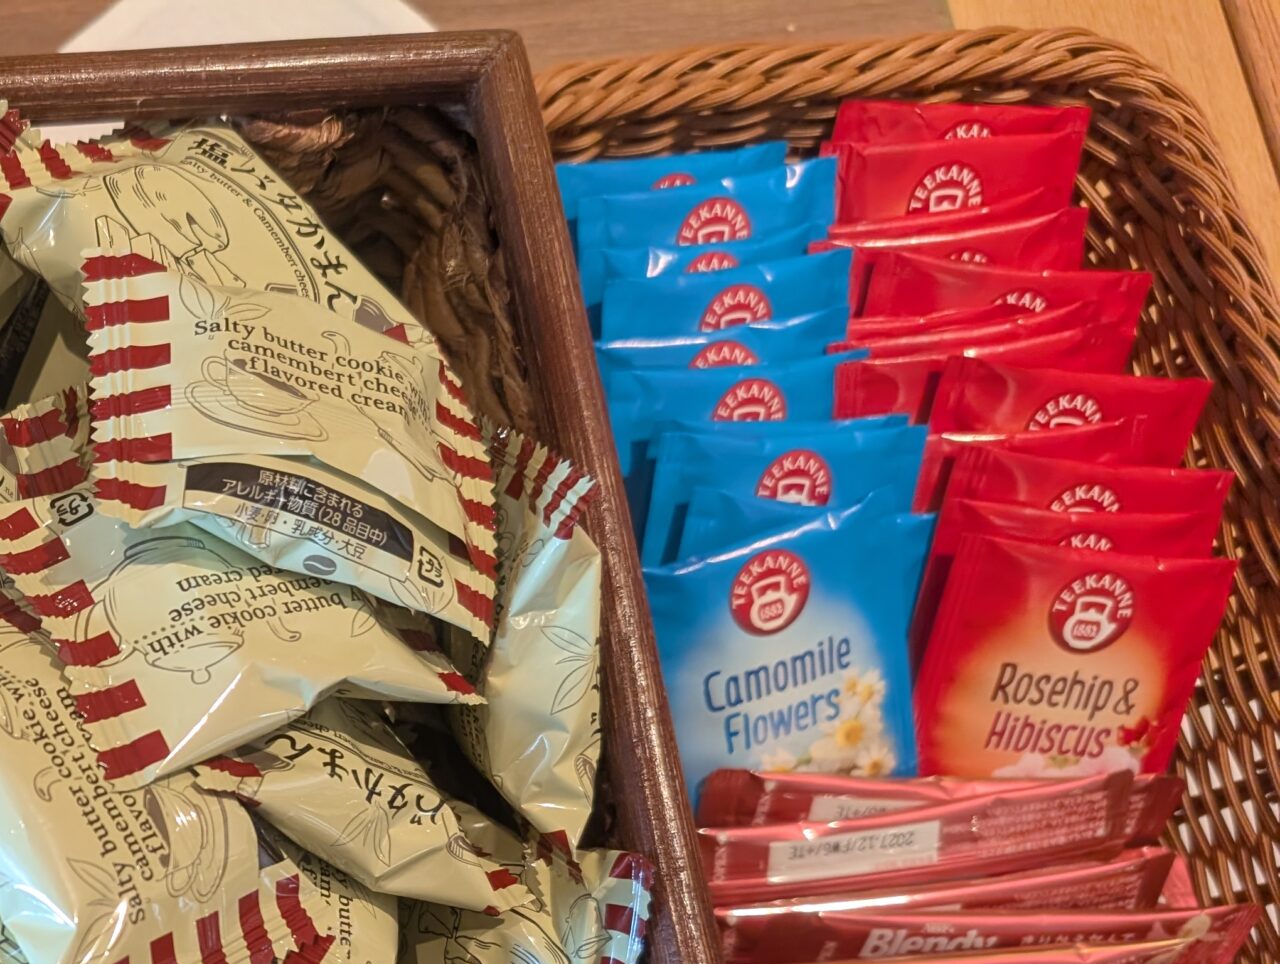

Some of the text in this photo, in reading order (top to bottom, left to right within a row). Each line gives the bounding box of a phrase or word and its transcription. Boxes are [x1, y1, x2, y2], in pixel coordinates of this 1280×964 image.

[909, 163, 982, 212] TEEKANNE
[253, 206, 299, 270] Camembert
[194, 317, 405, 385] Salty butter cookie
[227, 337, 356, 383] camembert
[248, 356, 345, 400] flavored
[258, 470, 364, 519] 原材料に含まれる
[758, 455, 828, 499] TEEKANNE
[176, 568, 245, 593] cream
[731, 554, 808, 610] TEEKANNE
[1052, 572, 1133, 620] TEEKANNE
[148, 589, 346, 656] butter cookie with
[169, 592, 243, 623] cheese
[702, 634, 852, 714] Camomile
[990, 661, 1140, 722] Rosehip &
[723, 688, 841, 755] Flowers
[983, 710, 1112, 759] Hibiscus
[24, 676, 156, 885] cheese camembert
[22, 707, 73, 781] cookie
[67, 783, 118, 860] butter
[111, 861, 147, 927] Salty
